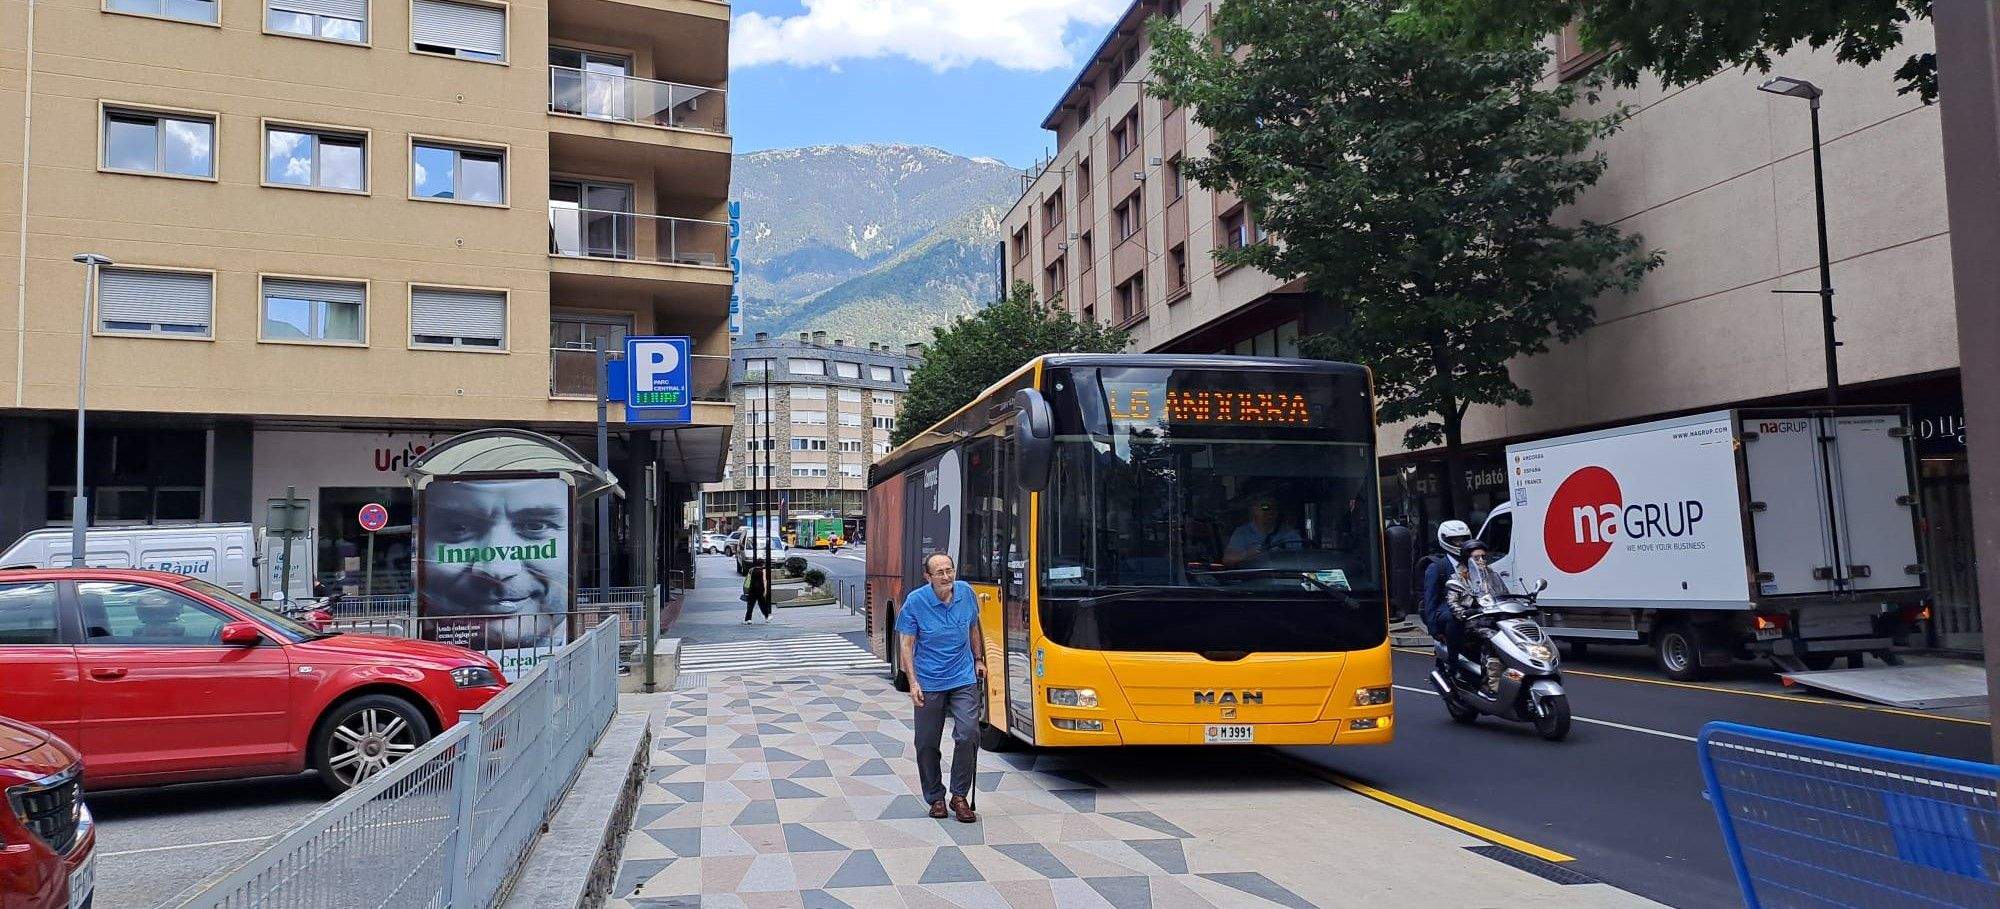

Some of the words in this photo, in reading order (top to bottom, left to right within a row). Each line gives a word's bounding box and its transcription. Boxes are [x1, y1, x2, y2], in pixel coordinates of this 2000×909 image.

[636, 342, 679, 391] P
[1672, 426, 1728, 439] WWW.NAGRUP.COM
[1572, 500, 1704, 544] naGRUP
[436, 538, 558, 564] Innovand
[1656, 543, 1672, 551] YOUR
[1673, 541, 1706, 550] BUSINESS
[1193, 691, 1264, 705] MAN
[1220, 726, 1227, 738] M
[1229, 726, 1251, 738] 3991
